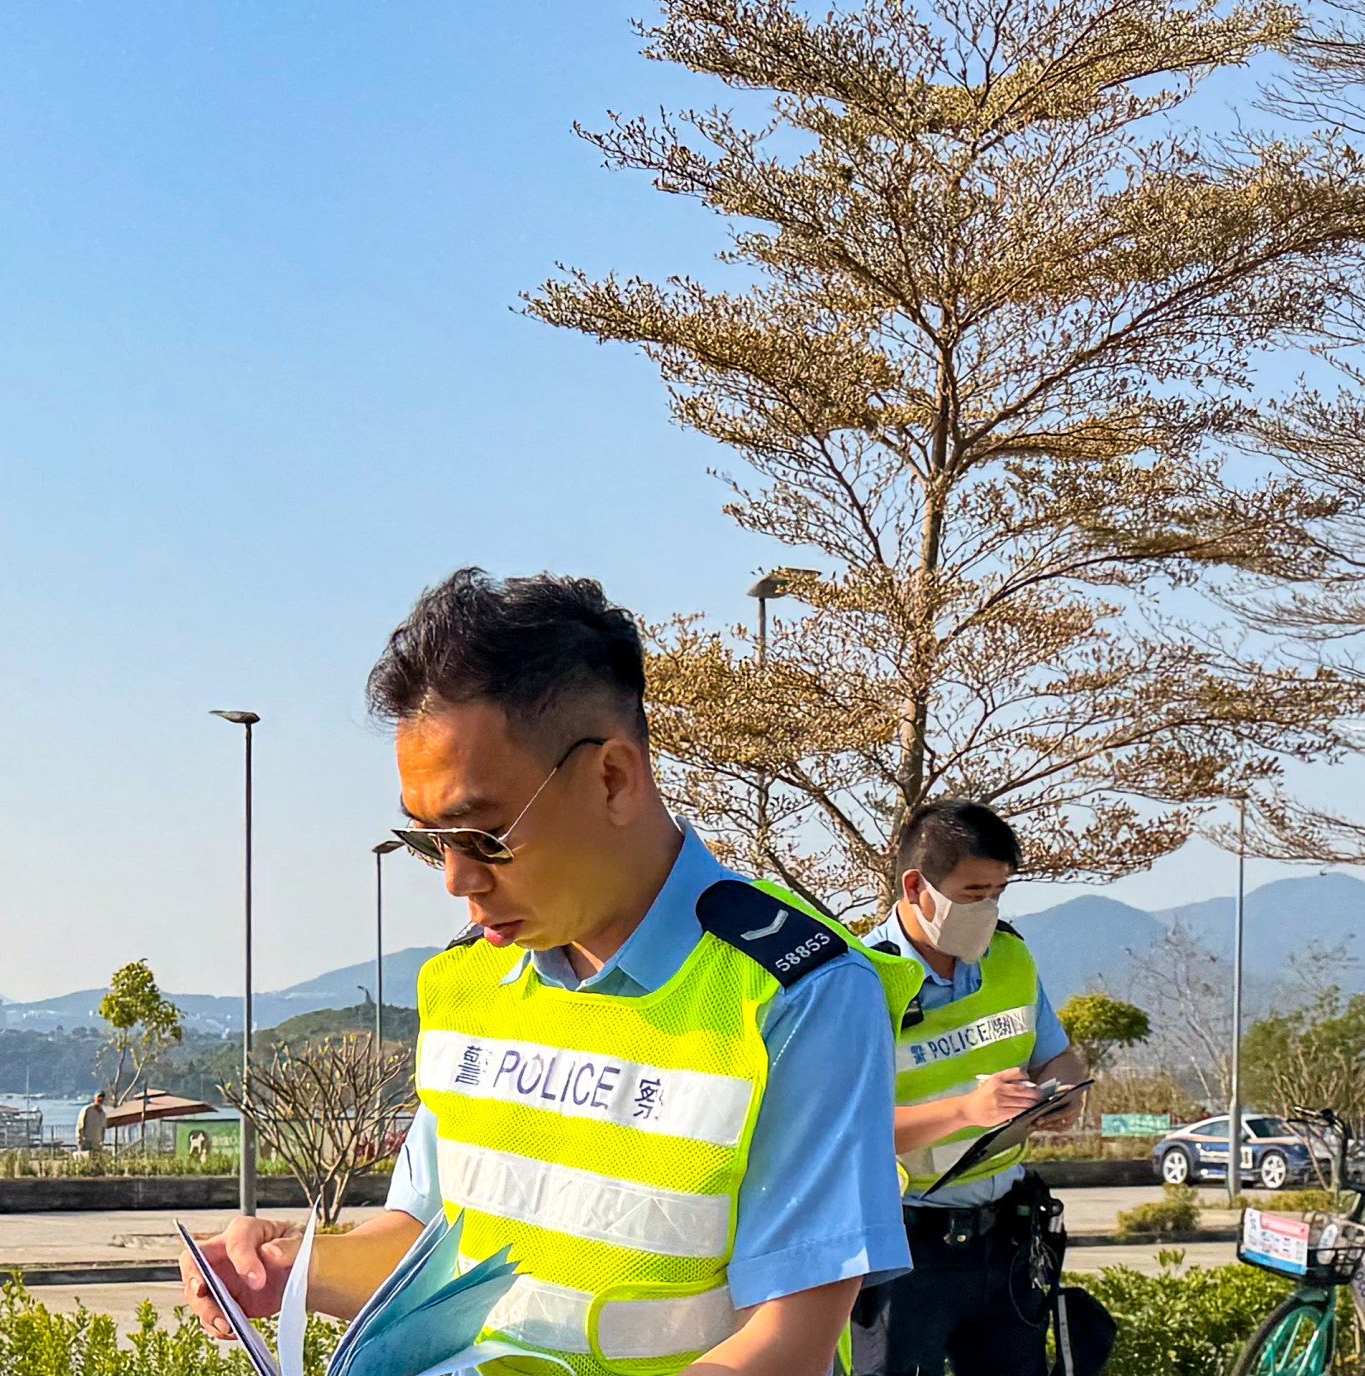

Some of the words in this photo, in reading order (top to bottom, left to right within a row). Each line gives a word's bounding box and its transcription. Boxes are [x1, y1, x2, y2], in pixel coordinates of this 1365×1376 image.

[775, 932, 831, 972] 58853
[927, 1022, 991, 1060] POLICE
[492, 1049, 621, 1110] POLICE
